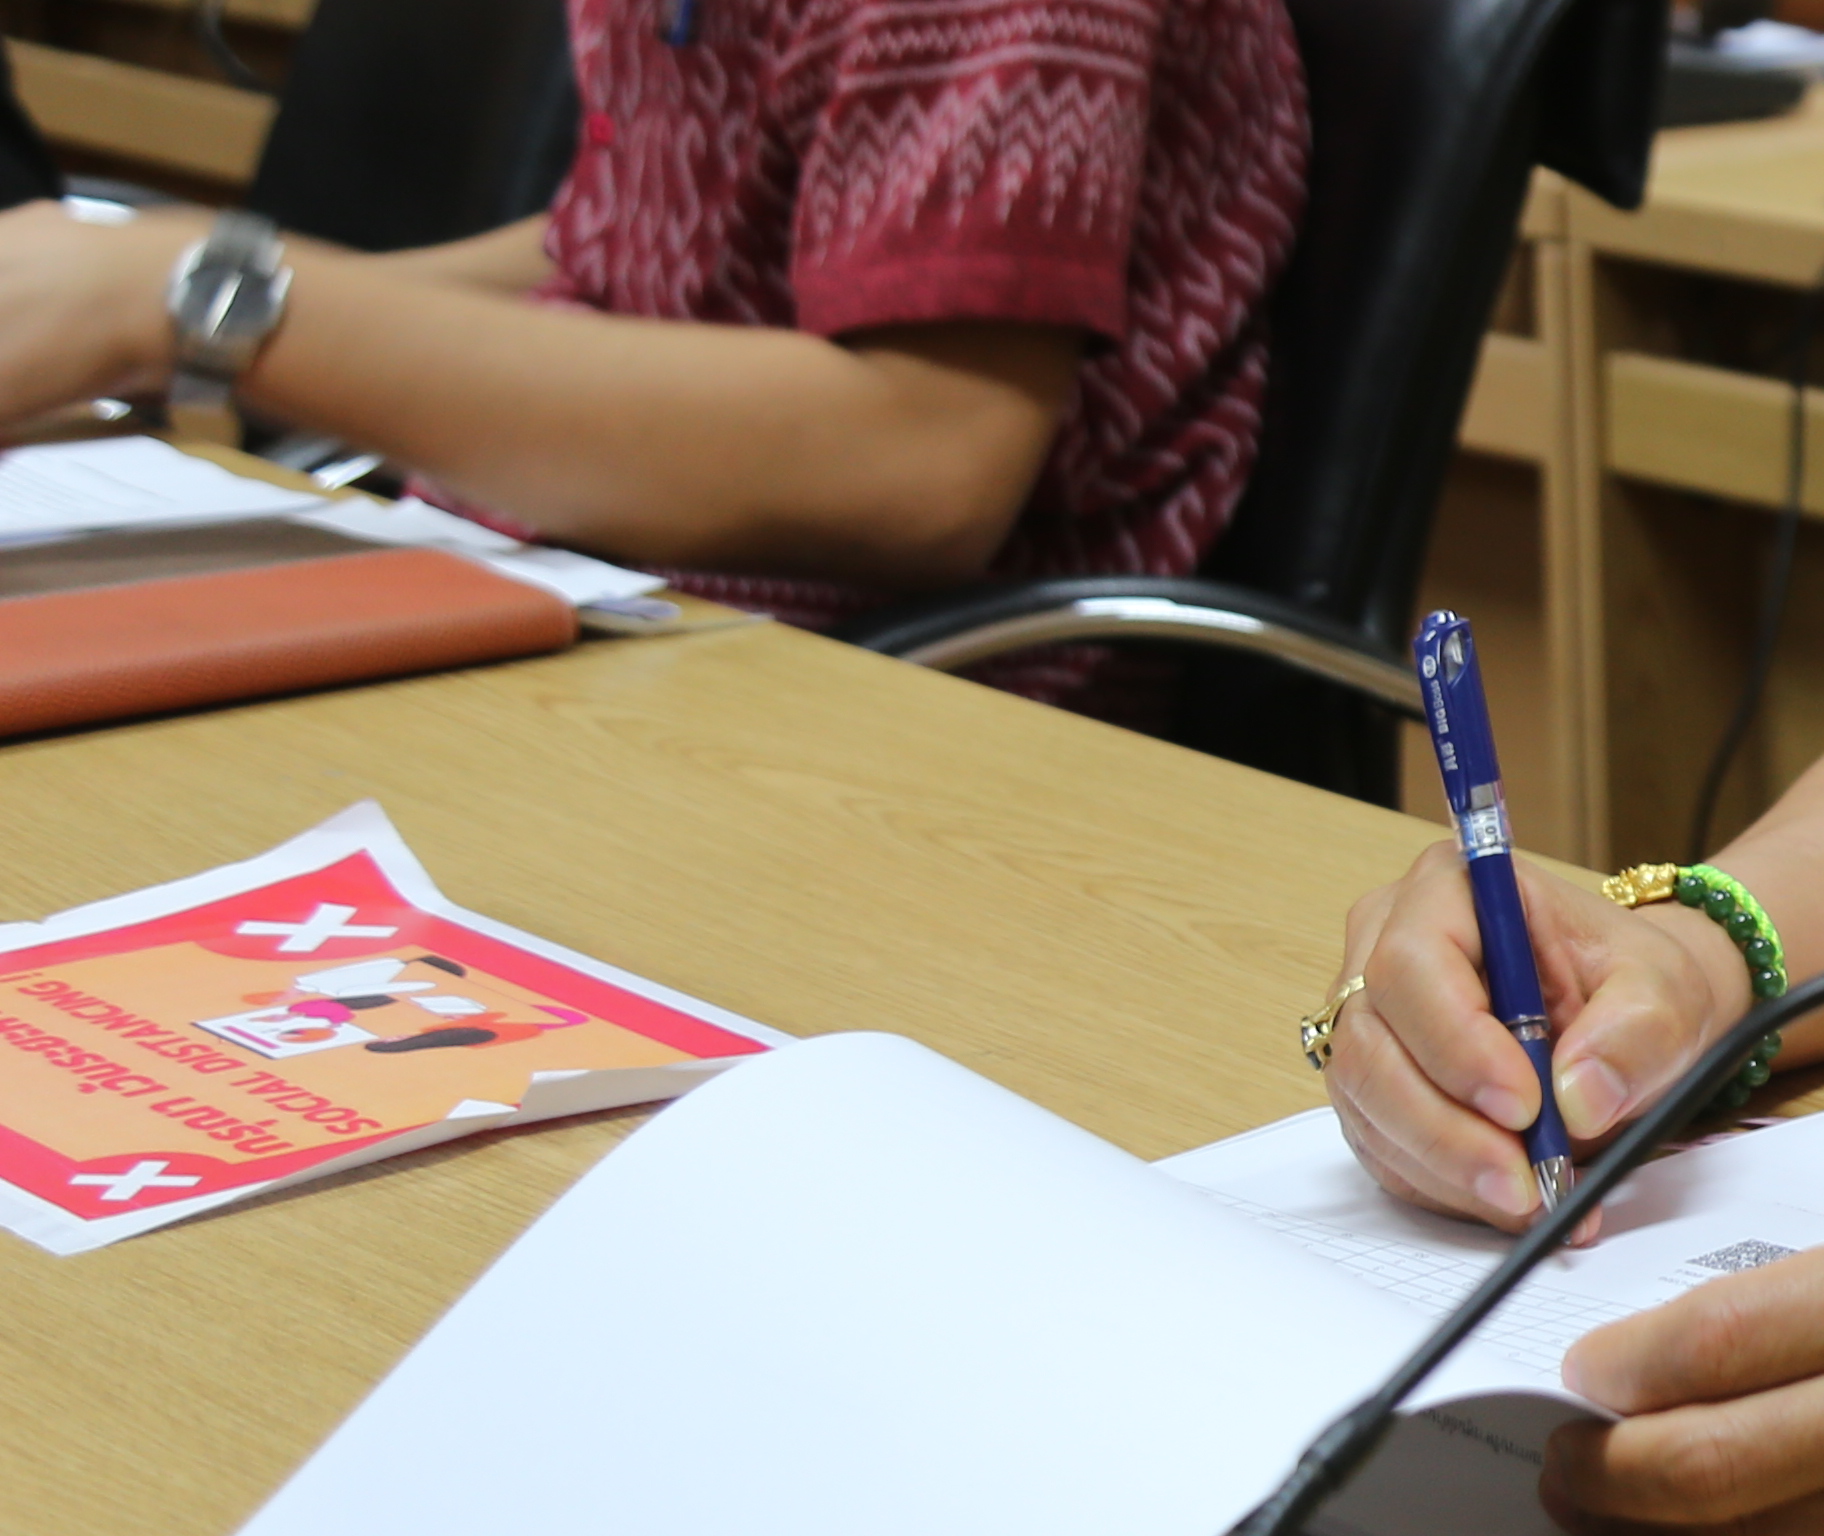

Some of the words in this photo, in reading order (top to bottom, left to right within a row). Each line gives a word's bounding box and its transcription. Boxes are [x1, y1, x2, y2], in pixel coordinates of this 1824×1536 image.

[16, 980, 248, 1075] DISTANCING
[149, 1096, 294, 1155] กรุณา
[229, 1070, 383, 1135] SOCIAL
